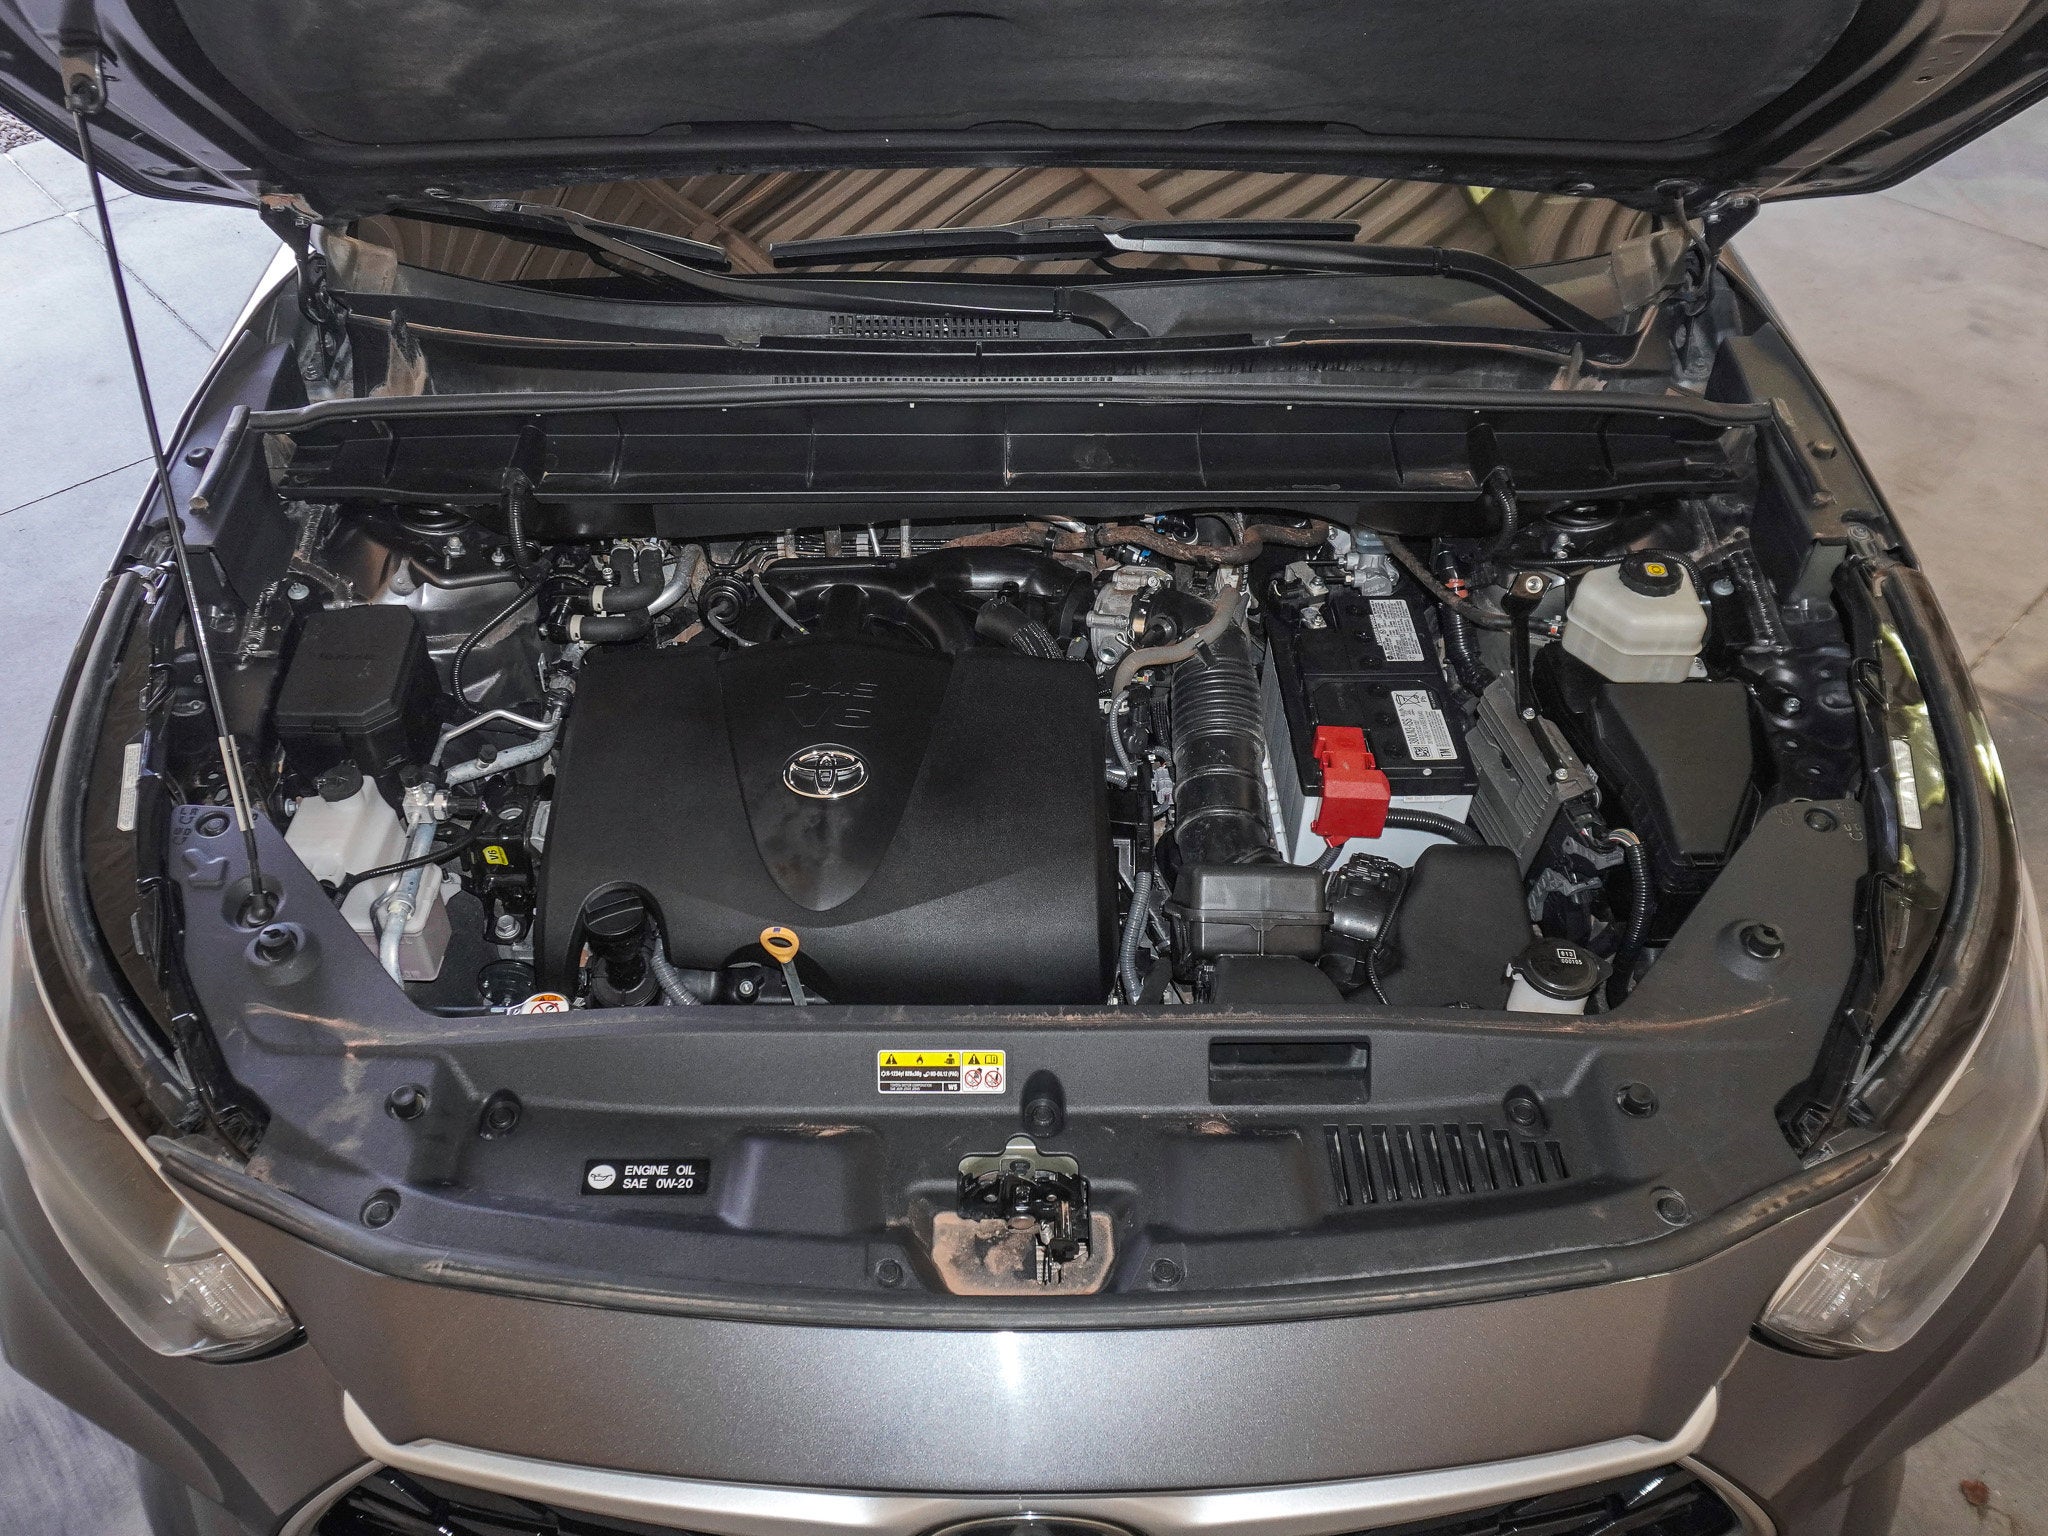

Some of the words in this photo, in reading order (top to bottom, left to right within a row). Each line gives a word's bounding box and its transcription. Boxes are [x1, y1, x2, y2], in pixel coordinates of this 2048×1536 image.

[624, 1165, 669, 1176] ENGINE
[675, 1165, 696, 1176] OIL
[622, 1178, 648, 1189] SAE
[655, 1178, 693, 1189] 0W-20
